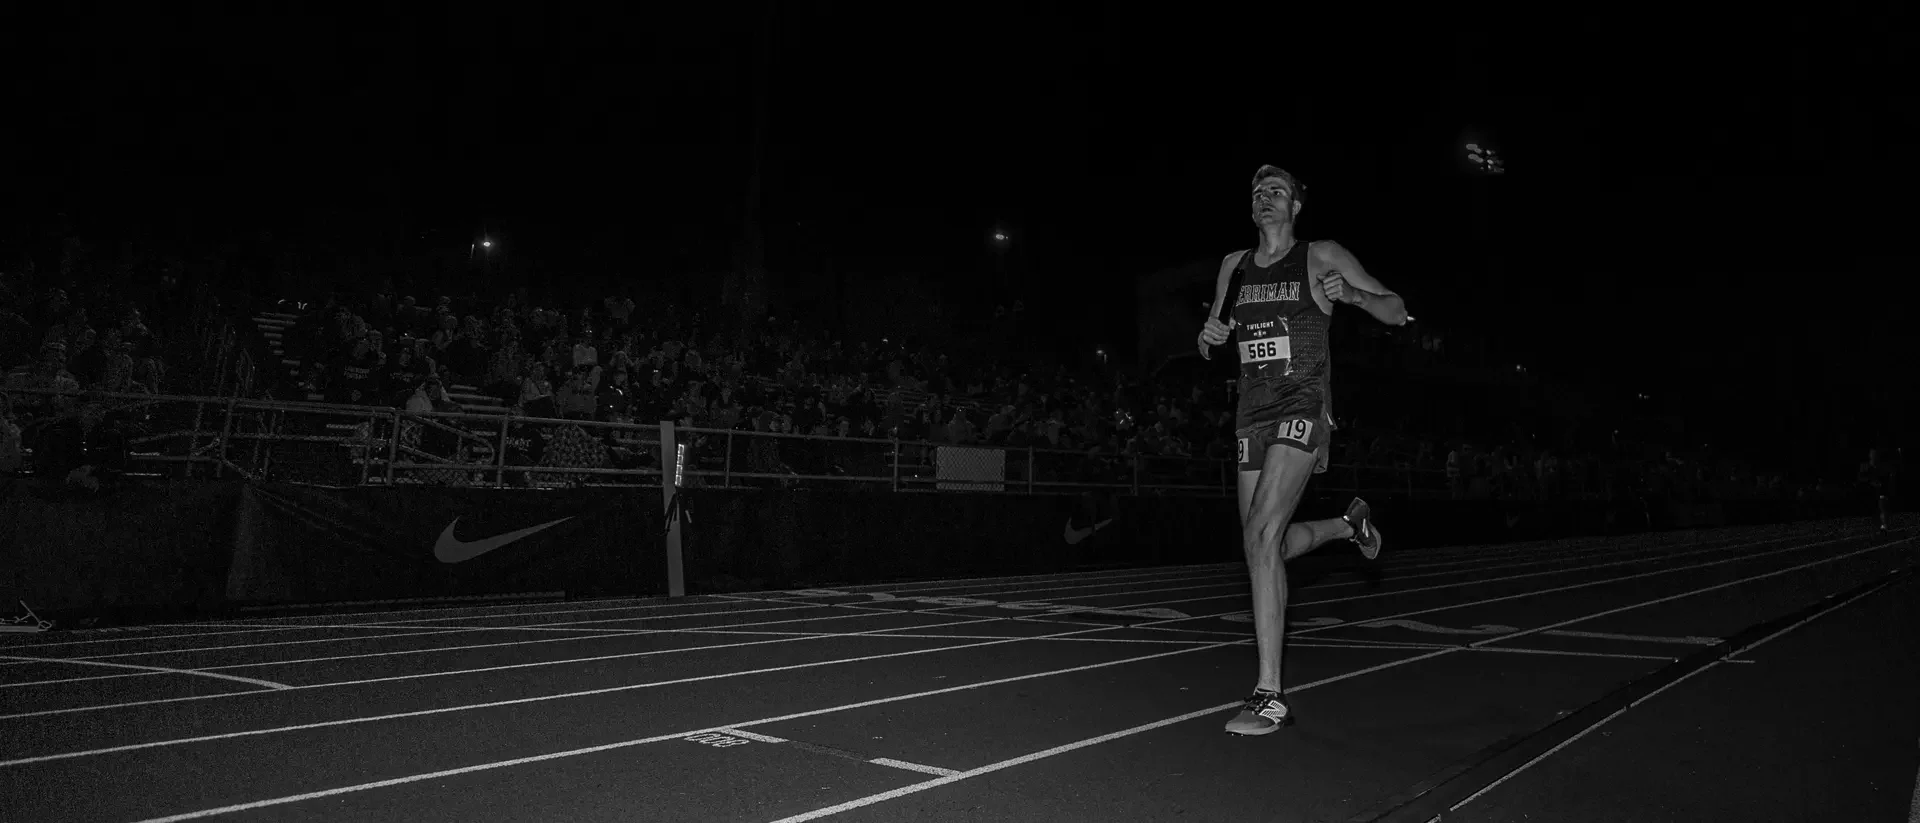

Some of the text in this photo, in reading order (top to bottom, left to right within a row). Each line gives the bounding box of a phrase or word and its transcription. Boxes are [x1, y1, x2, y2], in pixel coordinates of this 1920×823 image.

[1236, 281, 1301, 306] ERRIMAN
[1246, 320, 1274, 331] TWILIGHT
[1248, 341, 1277, 359] 566
[1285, 419, 1307, 440] 19
